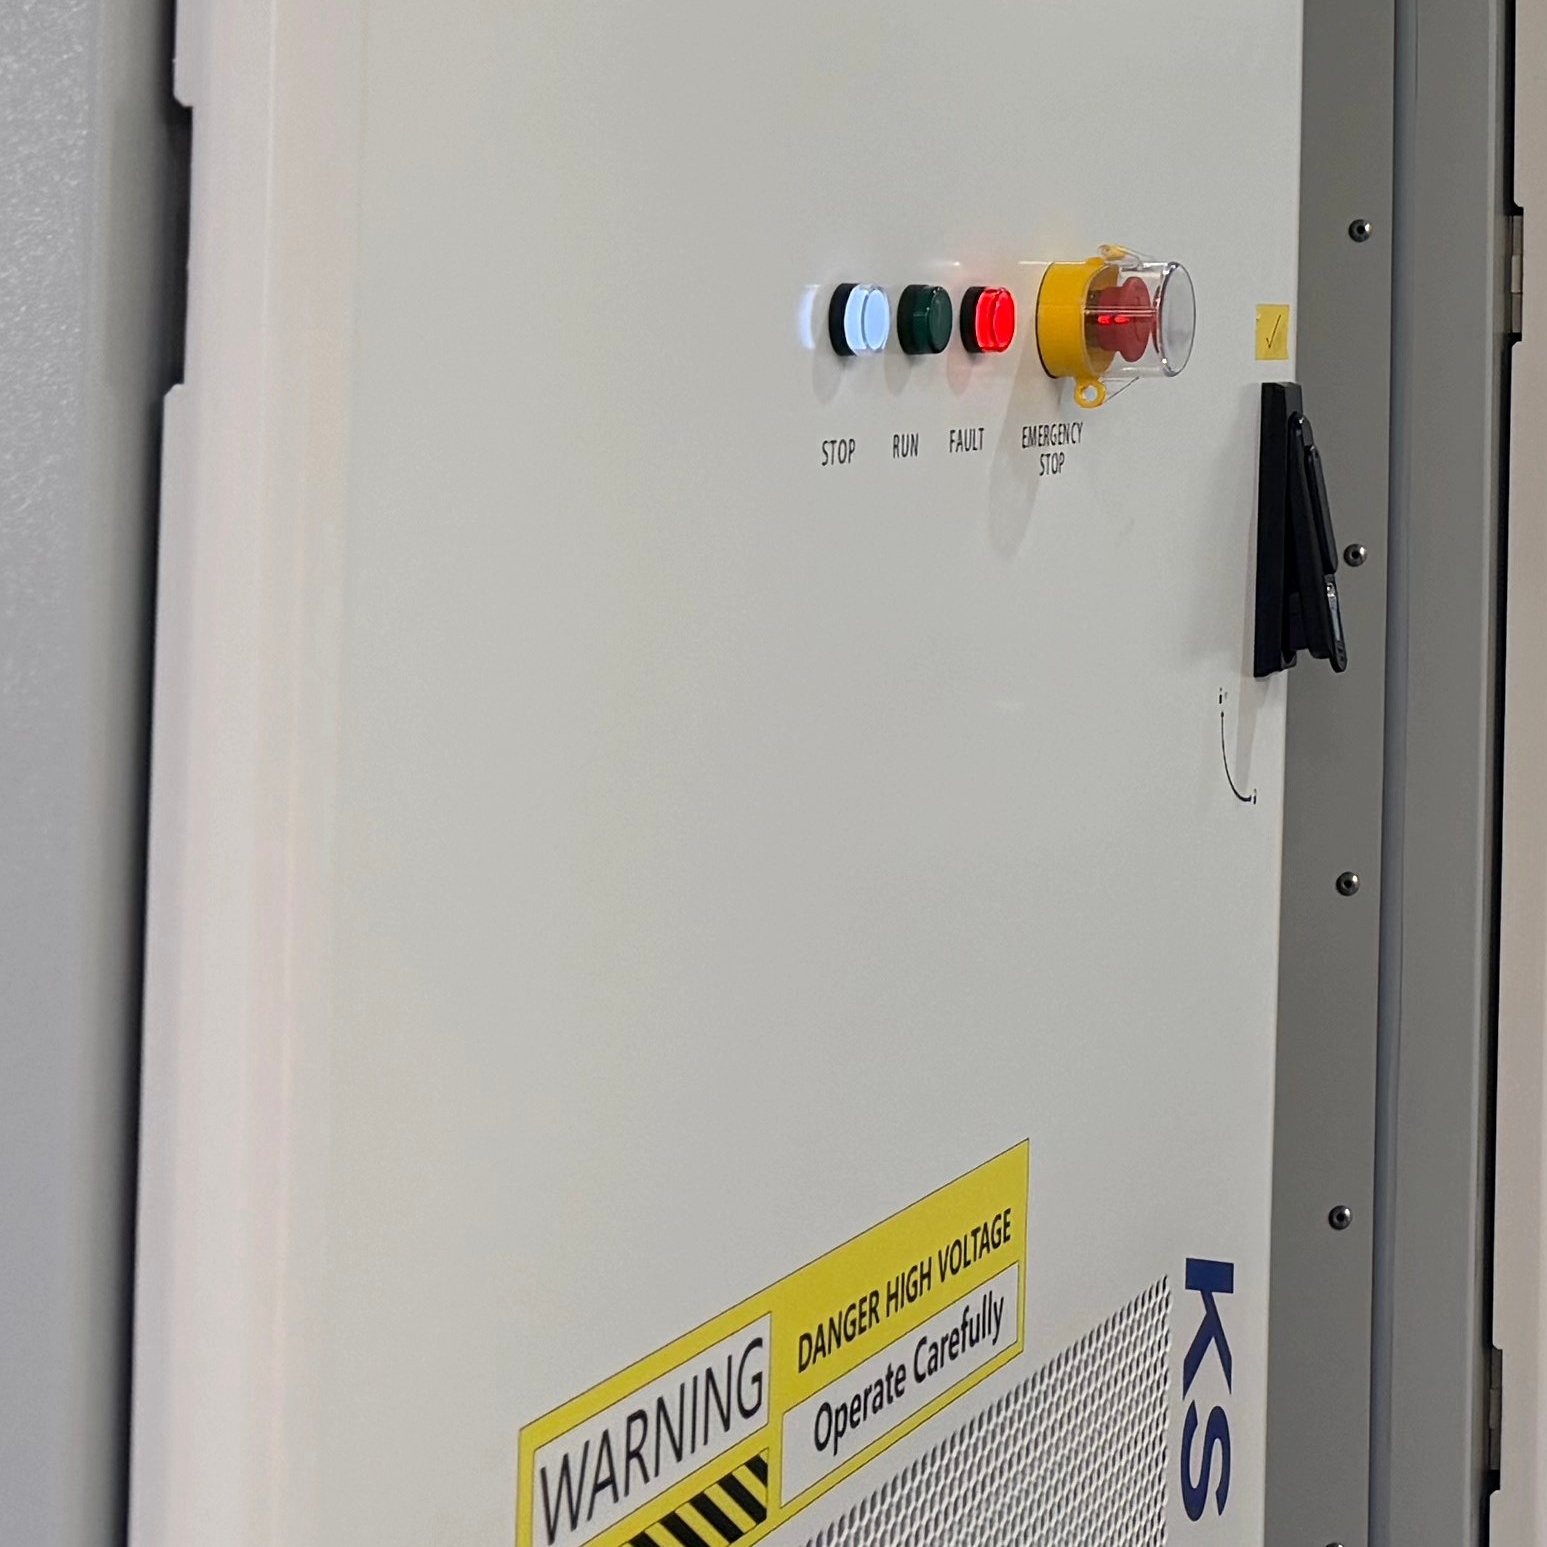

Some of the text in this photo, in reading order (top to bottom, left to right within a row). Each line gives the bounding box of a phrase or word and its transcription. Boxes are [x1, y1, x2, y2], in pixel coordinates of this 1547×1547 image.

[892, 433, 919, 460] RUN
[949, 427, 985, 454] FAULT
[1021, 421, 1084, 449] EMERGENCY
[821, 438, 856, 466] STOP
[1039, 451, 1065, 477] STOP
[797, 1207, 1012, 1374] DANGER HIGH VOLTAGE
[813, 1291, 1006, 1454] Operate Carefully
[1180, 1257, 1234, 1522] KS
[538, 1335, 765, 1546] WARNING
